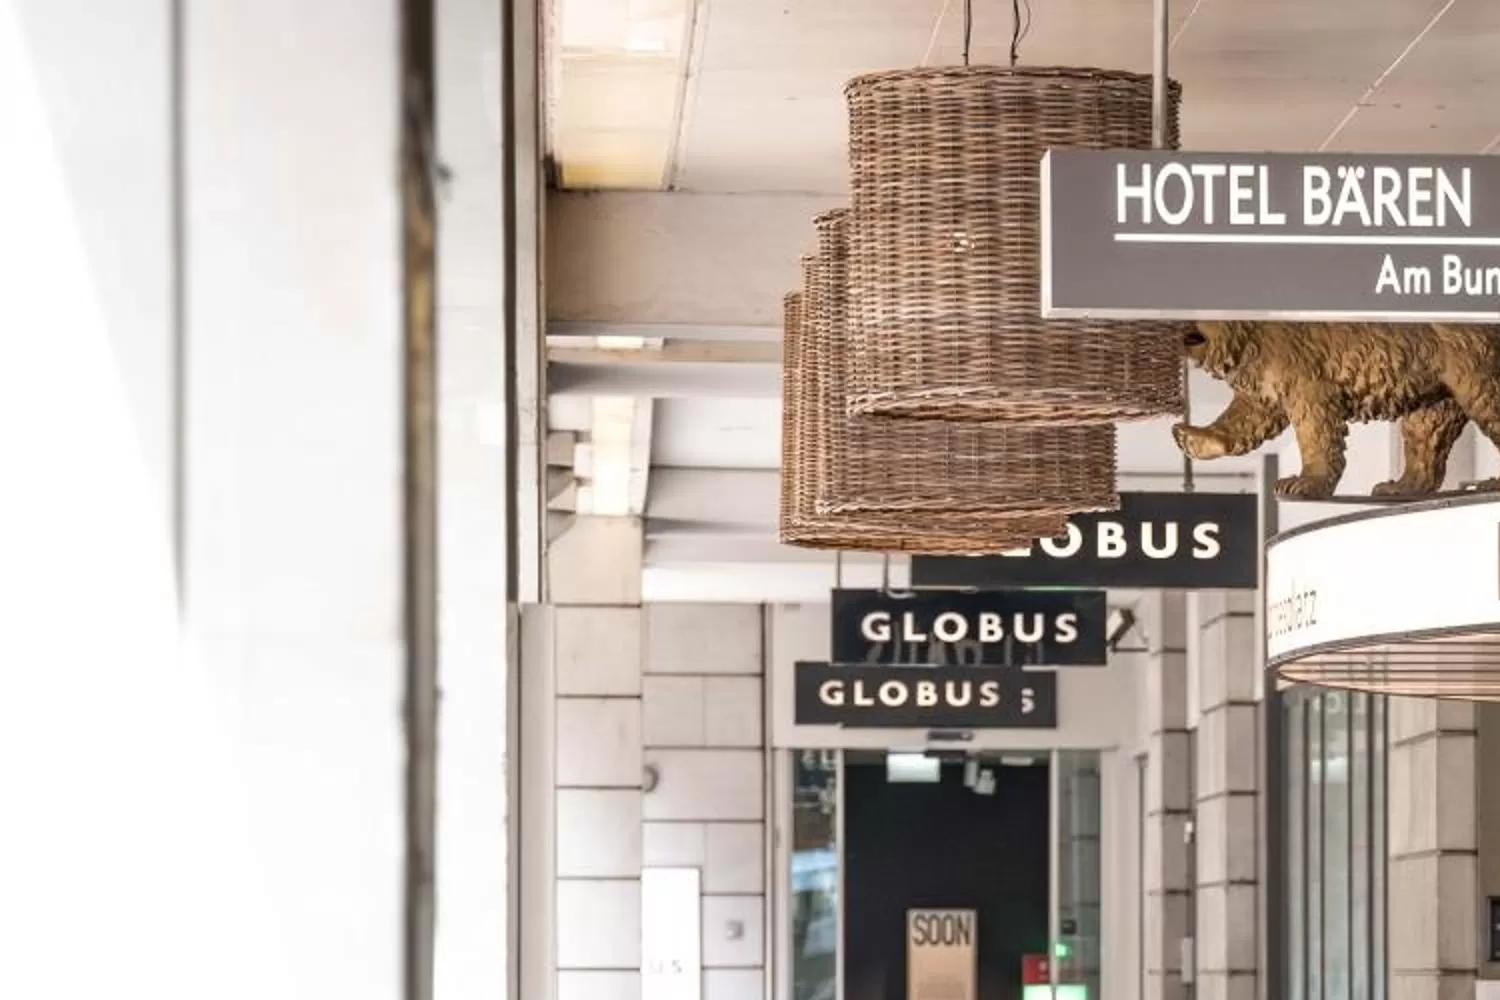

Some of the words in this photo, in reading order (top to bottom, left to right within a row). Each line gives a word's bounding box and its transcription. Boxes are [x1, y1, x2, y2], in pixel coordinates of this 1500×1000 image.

[1116, 162, 1287, 225] HOTEL
[1303, 165, 1472, 227] BÄREN
[1375, 253, 1431, 294] Am
[983, 520, 1221, 559] OBUS
[861, 611, 1078, 643] GLOBUS
[819, 680, 1000, 707] GLOBUS
[912, 914, 971, 946] SOON
